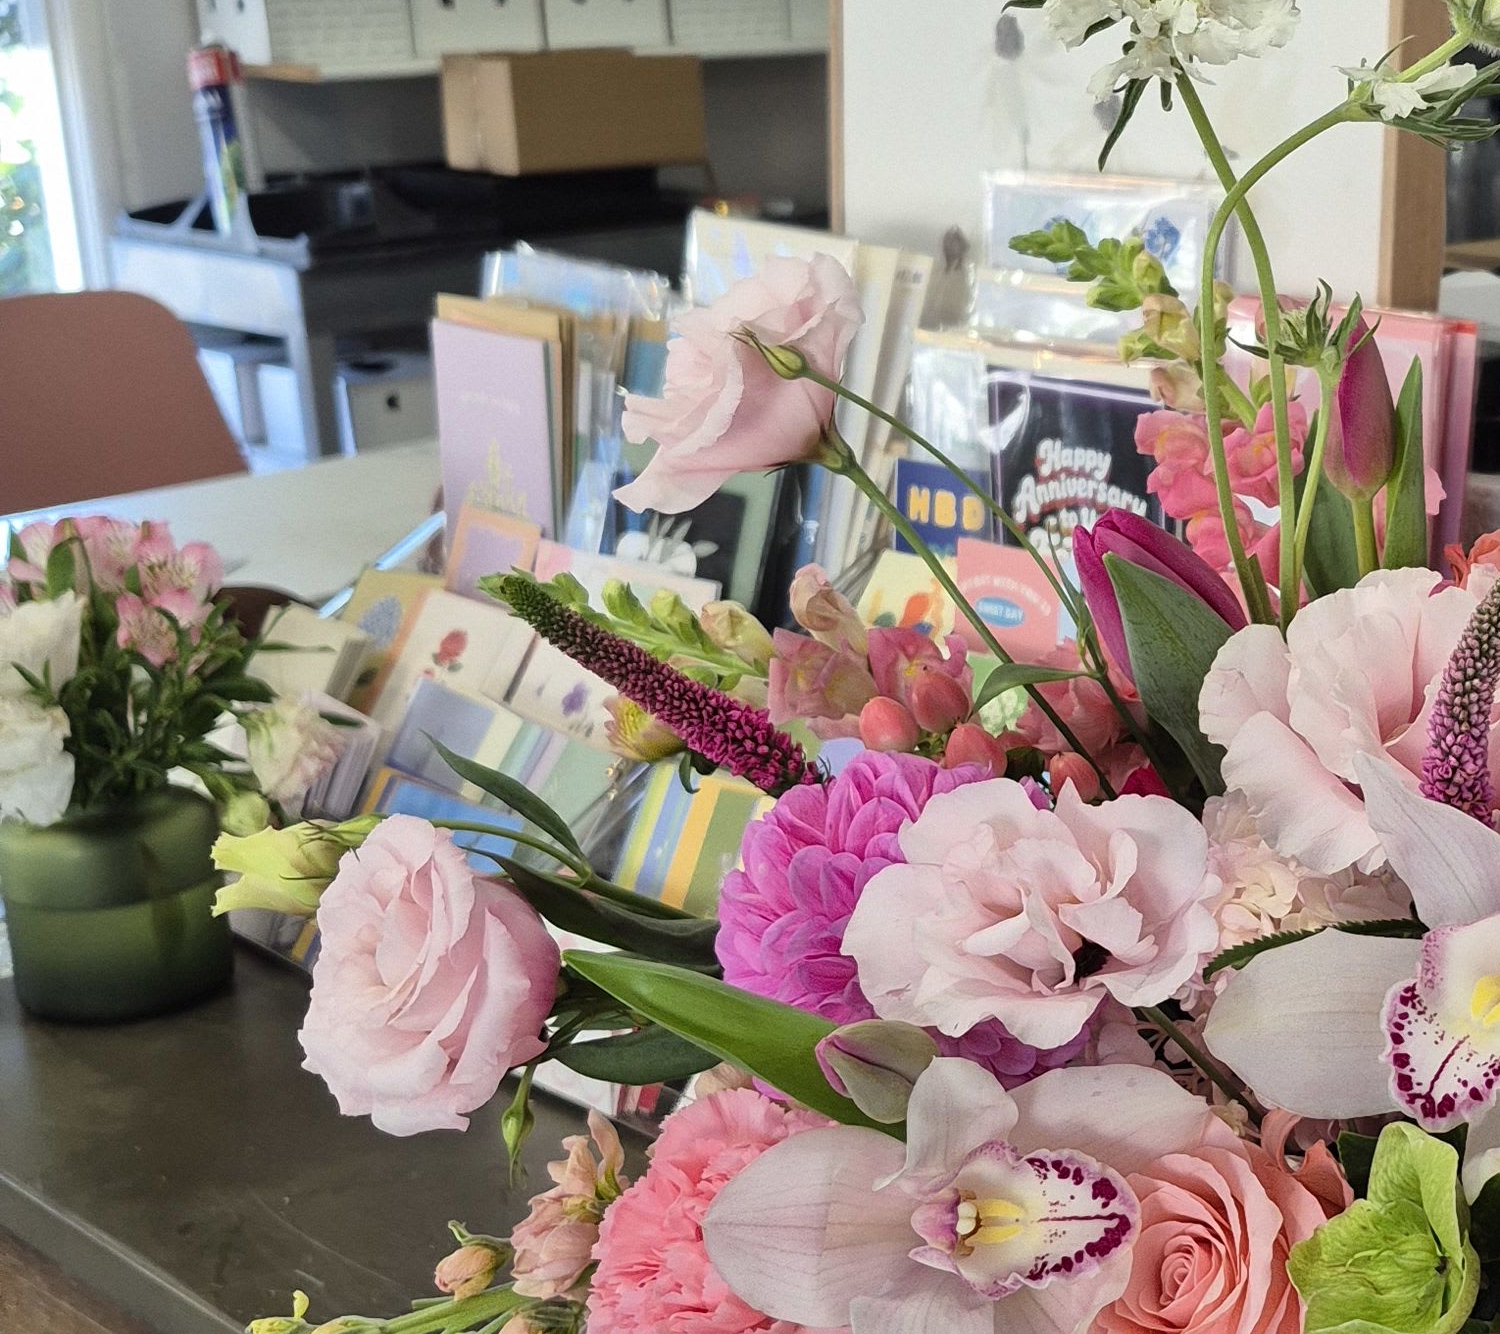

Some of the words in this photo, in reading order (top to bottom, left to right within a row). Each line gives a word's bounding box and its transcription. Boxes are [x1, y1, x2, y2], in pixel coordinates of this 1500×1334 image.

[1037, 437, 1112, 481] Happy
[909, 485, 985, 533] HBD
[1013, 474, 1148, 524] Anniversary
